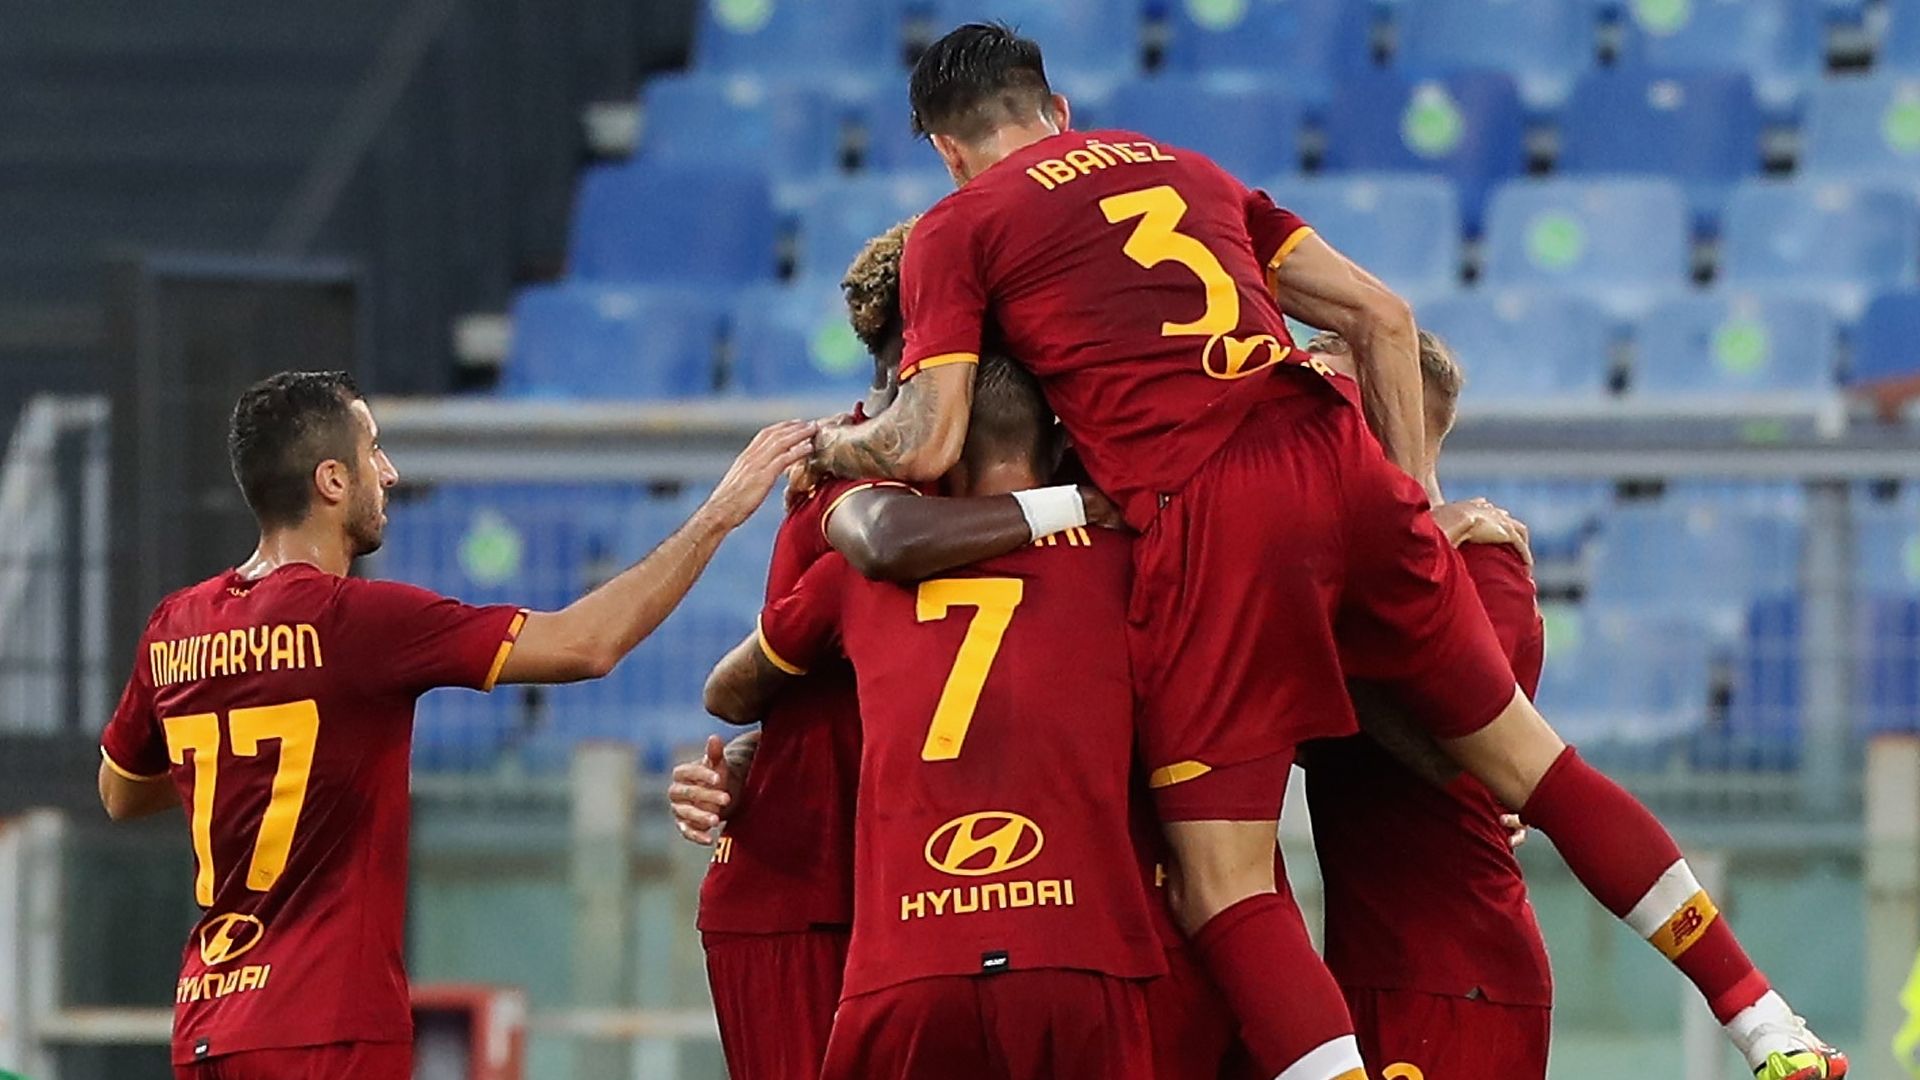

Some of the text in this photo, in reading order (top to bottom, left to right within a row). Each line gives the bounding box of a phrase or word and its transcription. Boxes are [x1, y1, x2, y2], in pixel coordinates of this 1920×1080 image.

[1026, 139, 1177, 190] IBAÑEZ
[1099, 185, 1239, 336] 3
[149, 623, 323, 687] MKHITARYAN
[916, 577, 1024, 762] 7
[163, 699, 320, 908] 77
[900, 879, 1074, 921] HYUNDAI
